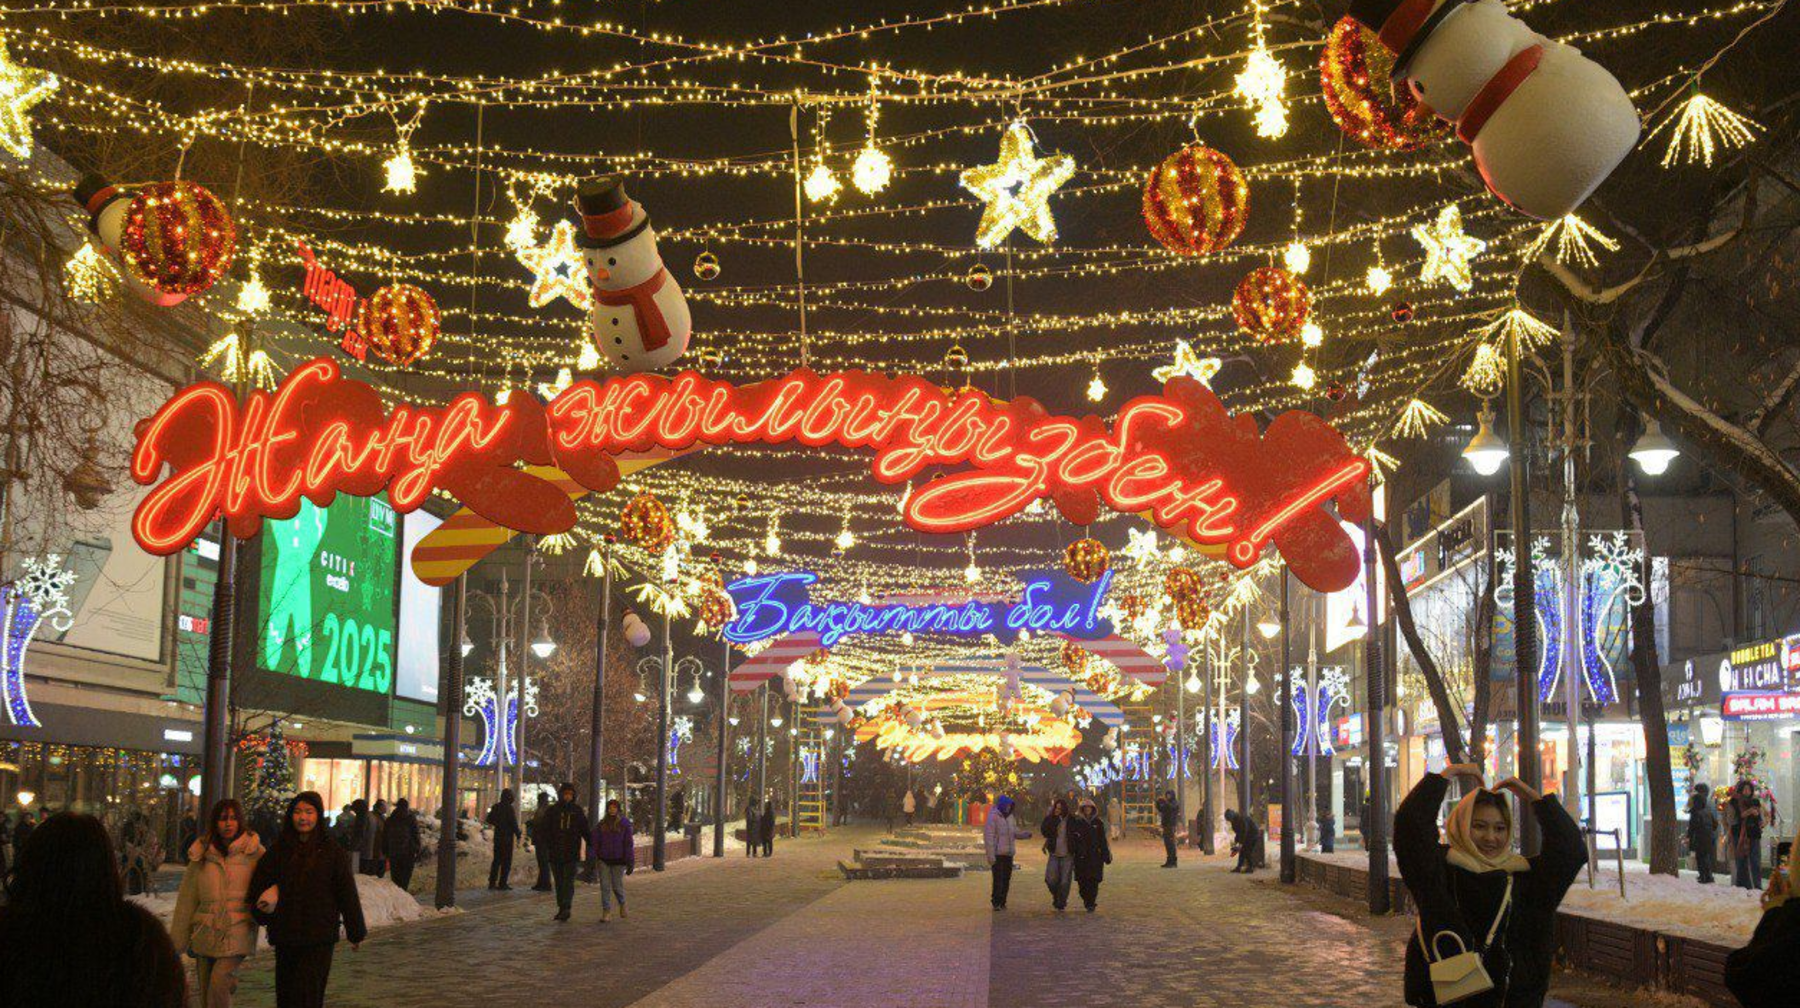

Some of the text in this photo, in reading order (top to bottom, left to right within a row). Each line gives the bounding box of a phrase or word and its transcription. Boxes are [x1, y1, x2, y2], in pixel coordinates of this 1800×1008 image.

[134, 361, 511, 547] Жаңа
[723, 569, 1114, 646] Бақытты бол!
[320, 612, 392, 694] 2025
[1760, 641, 1776, 658] TEA
